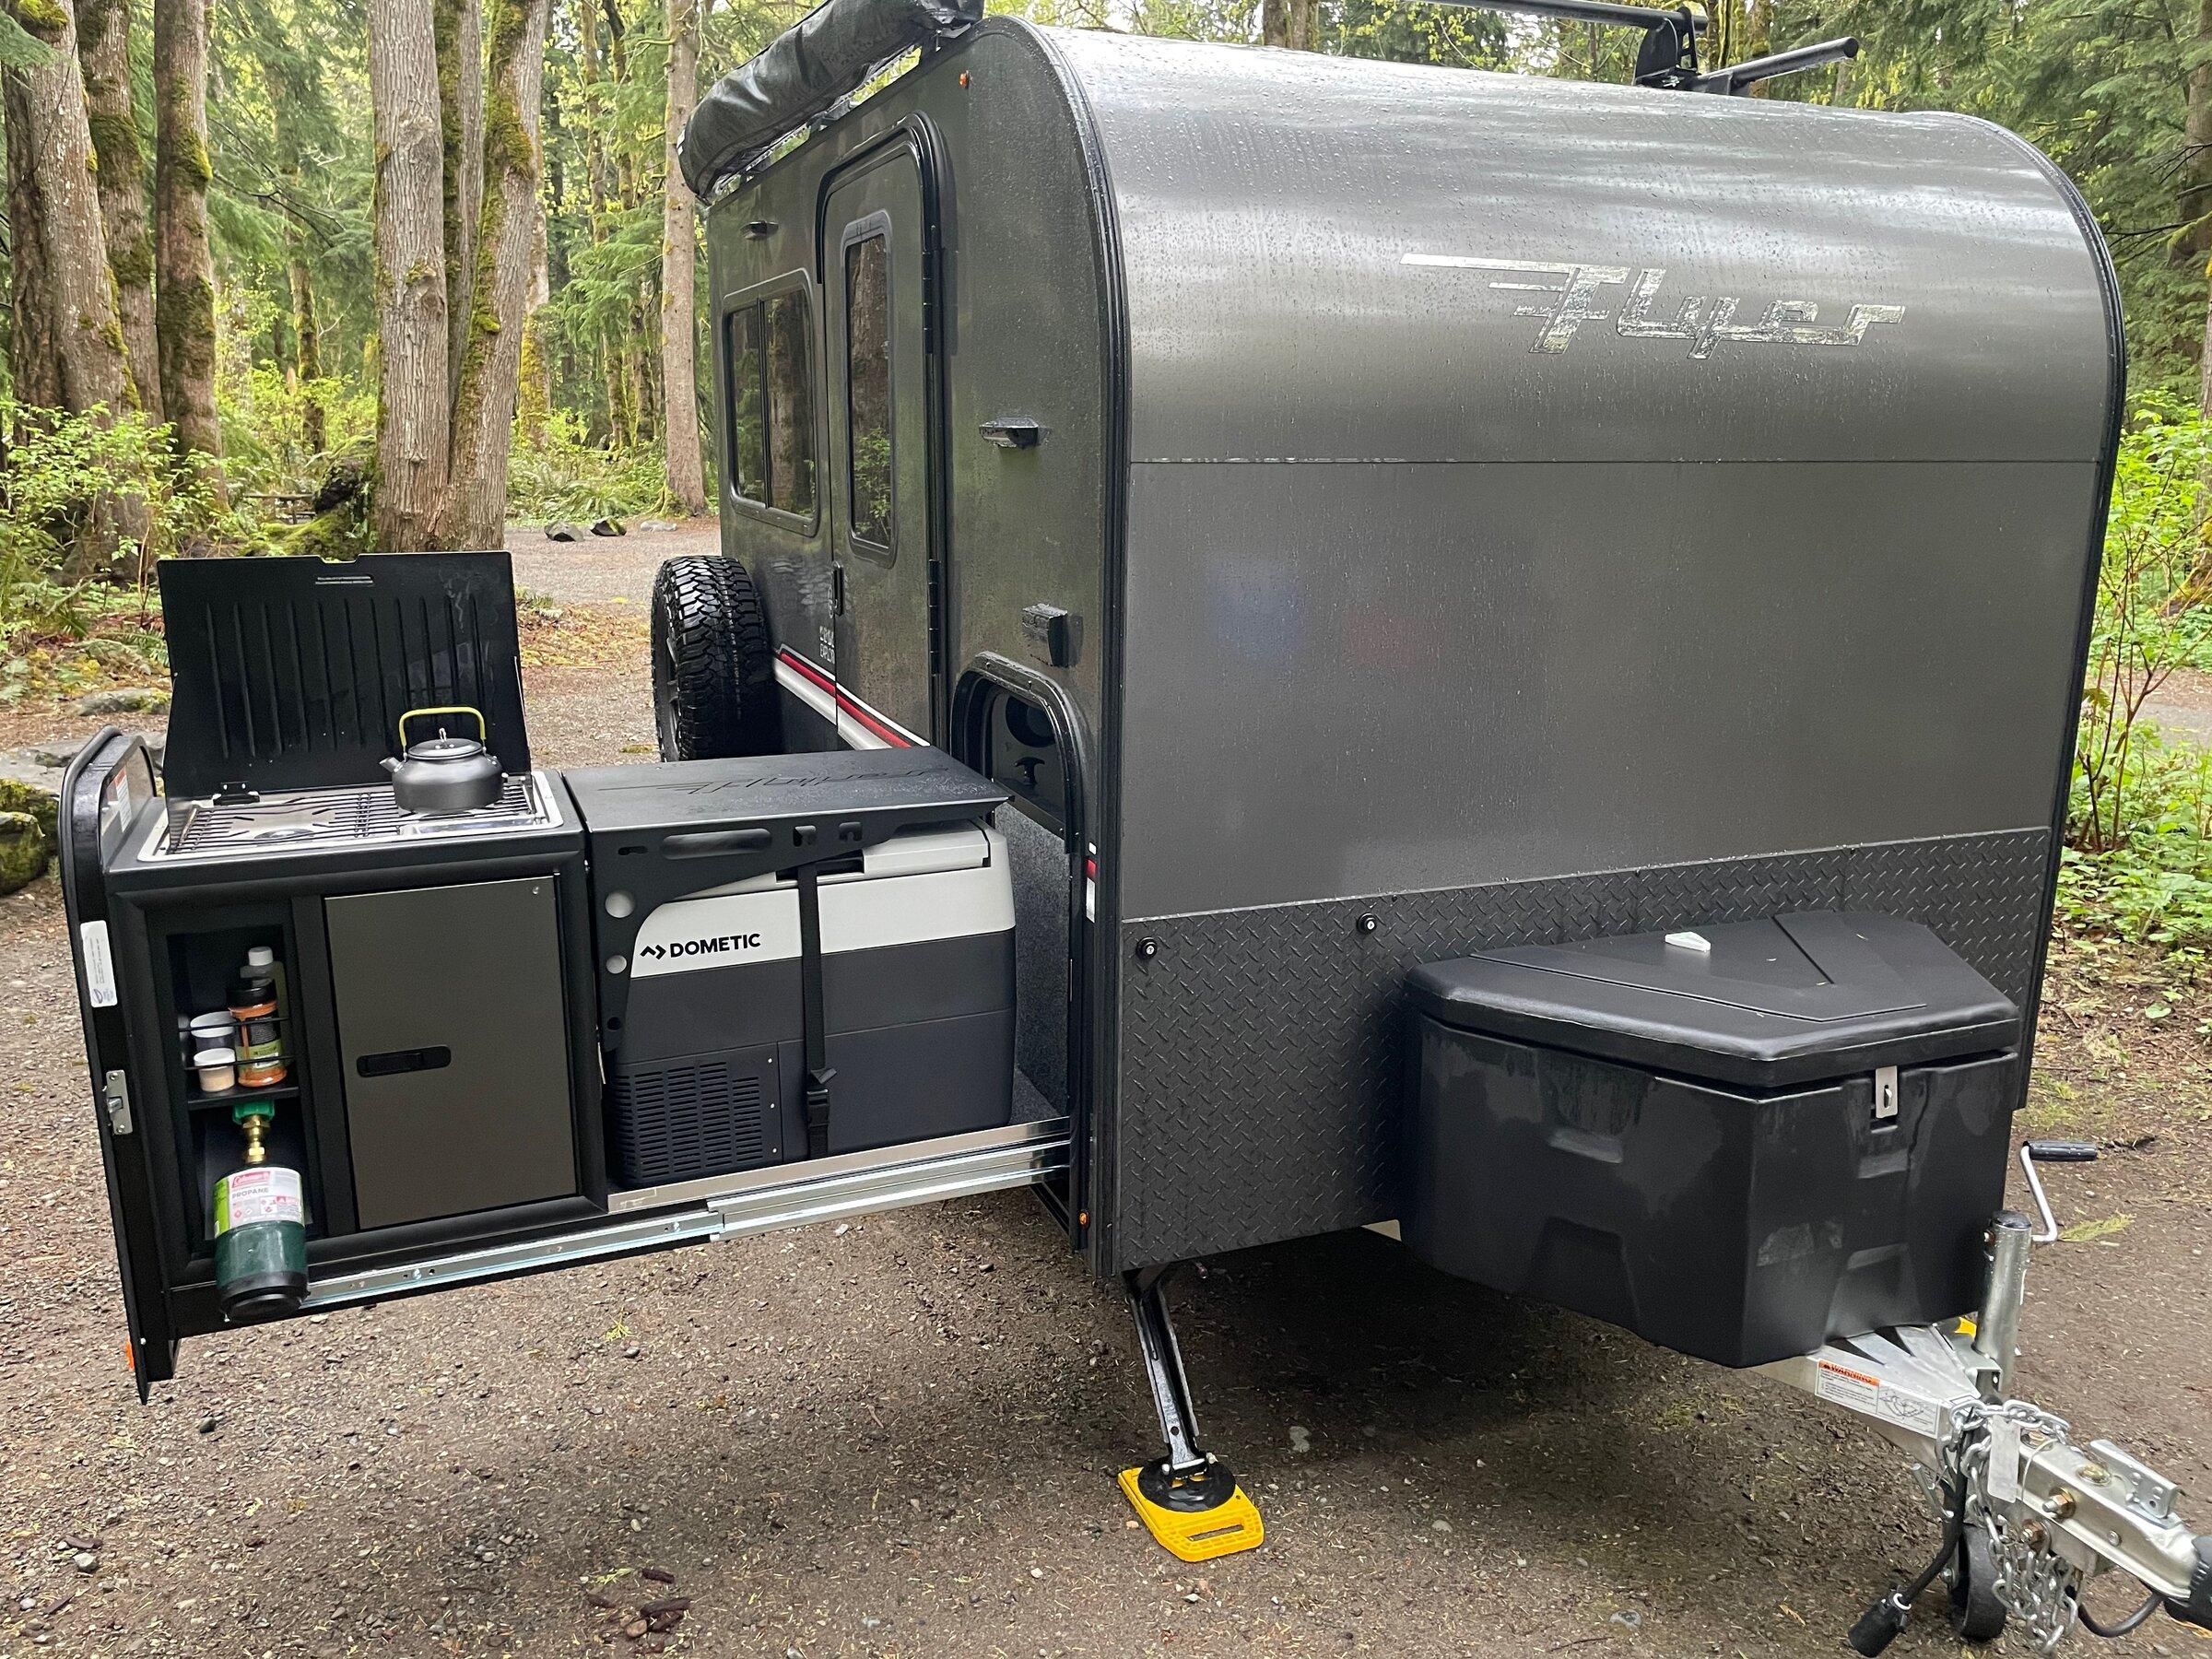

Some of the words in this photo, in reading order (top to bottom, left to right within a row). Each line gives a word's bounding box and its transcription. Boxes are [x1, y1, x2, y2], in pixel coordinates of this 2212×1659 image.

[1399, 253, 1906, 360] Flyer
[669, 933, 761, 958] DOMETIC
[231, 1187, 270, 1199] PROPANE
